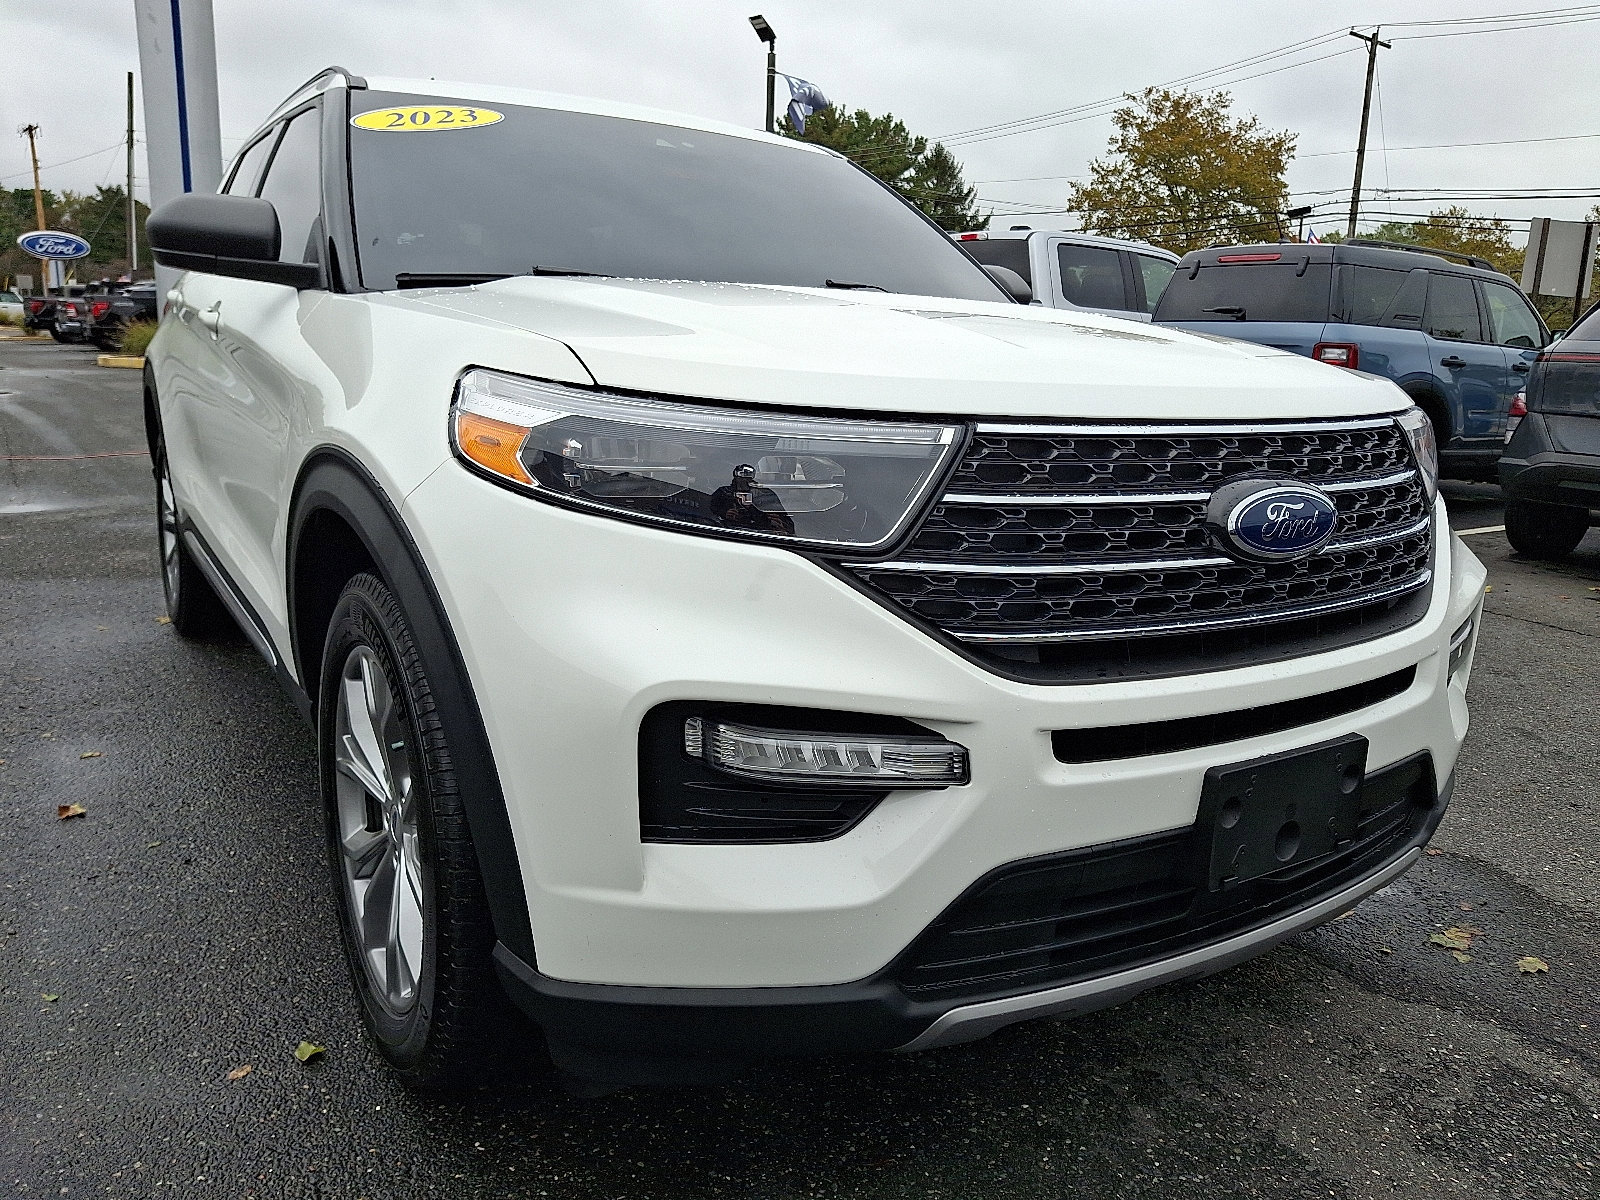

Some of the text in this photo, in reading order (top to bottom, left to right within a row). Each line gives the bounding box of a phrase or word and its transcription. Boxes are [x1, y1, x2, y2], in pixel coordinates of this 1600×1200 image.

[386, 109, 478, 128] 2023
[35, 237, 77, 254] Ford
[1261, 502, 1320, 542] Ford
